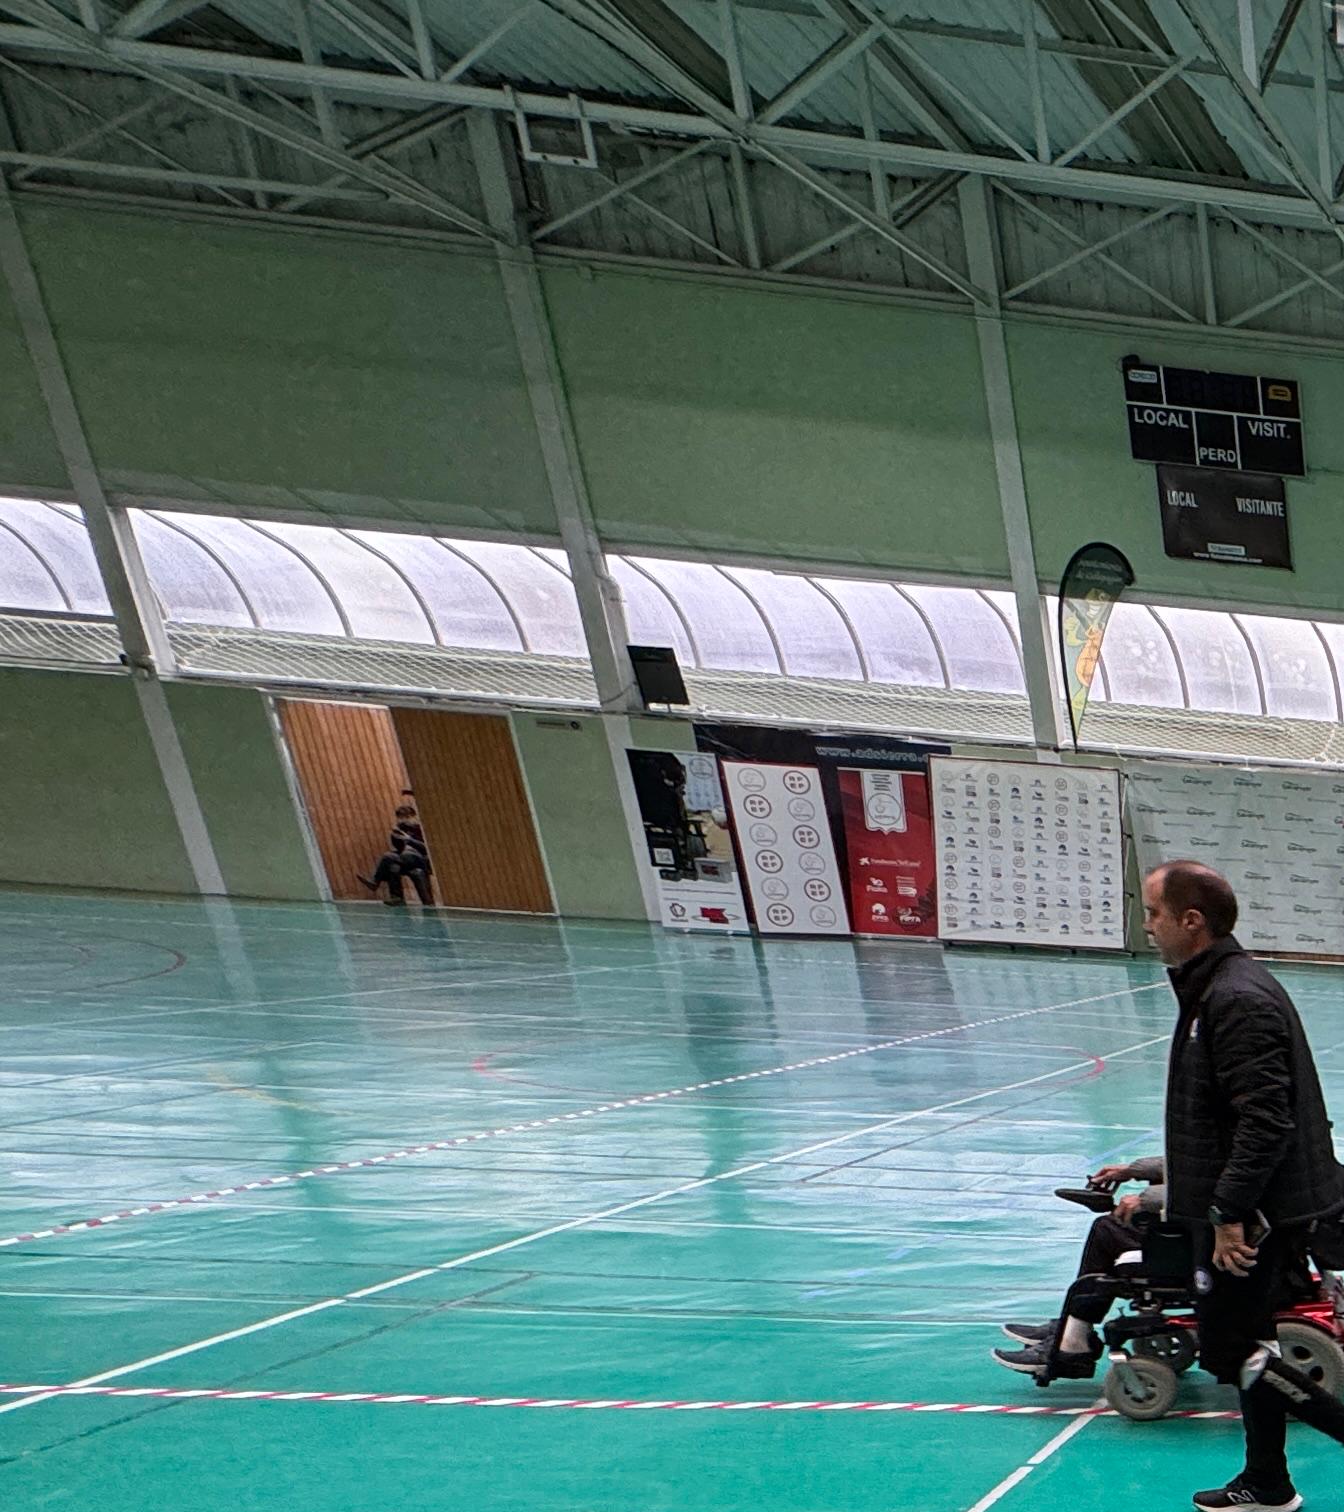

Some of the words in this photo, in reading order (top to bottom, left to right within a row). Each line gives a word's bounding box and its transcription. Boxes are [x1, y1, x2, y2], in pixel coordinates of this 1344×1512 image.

[1133, 407, 1189, 429] LOCAL
[1247, 420, 1292, 440] VISIT.
[1199, 446, 1236, 463] PERD
[1167, 489, 1199, 509] LOCAL
[1235, 497, 1286, 518] VISITANTE
